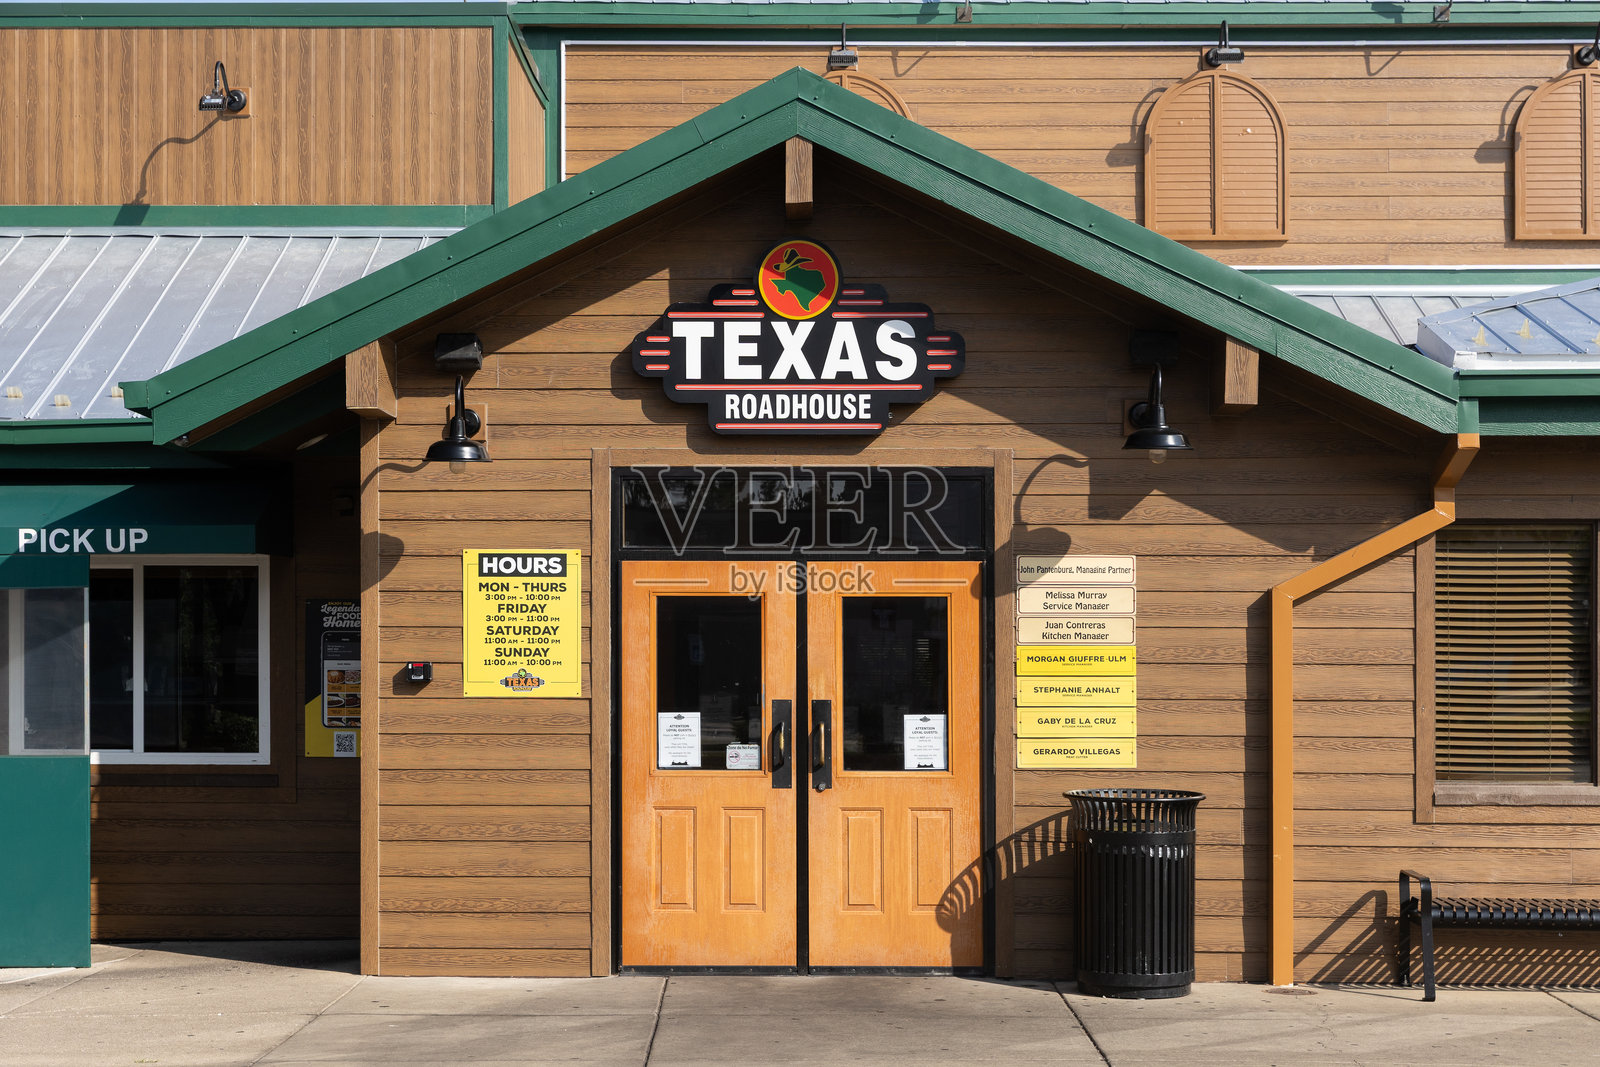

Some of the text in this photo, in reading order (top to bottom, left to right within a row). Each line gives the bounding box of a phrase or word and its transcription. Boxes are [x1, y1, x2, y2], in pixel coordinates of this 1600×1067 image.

[672, 320, 918, 381] TEXAS
[725, 393, 871, 419] ROADHOUSE
[18, 528, 149, 553] PICK UP
[482, 556, 563, 574] HOURS
[1020, 566, 1035, 574] John
[1076, 566, 1107, 574] Managing
[1108, 566, 1131, 574] Partner
[478, 582, 510, 592] MON
[522, 582, 567, 592] THURS
[1045, 591, 1107, 599] Melissa Murray
[497, 603, 547, 613] FRIDAY
[1043, 602, 1110, 610] Service Manager
[486, 625, 559, 635] SATURDAY
[1045, 621, 1106, 629] Juan Contreras
[1042, 632, 1109, 640] Kitchen Manager
[495, 647, 550, 657] SUNDAY
[507, 677, 539, 686] TEXAS
